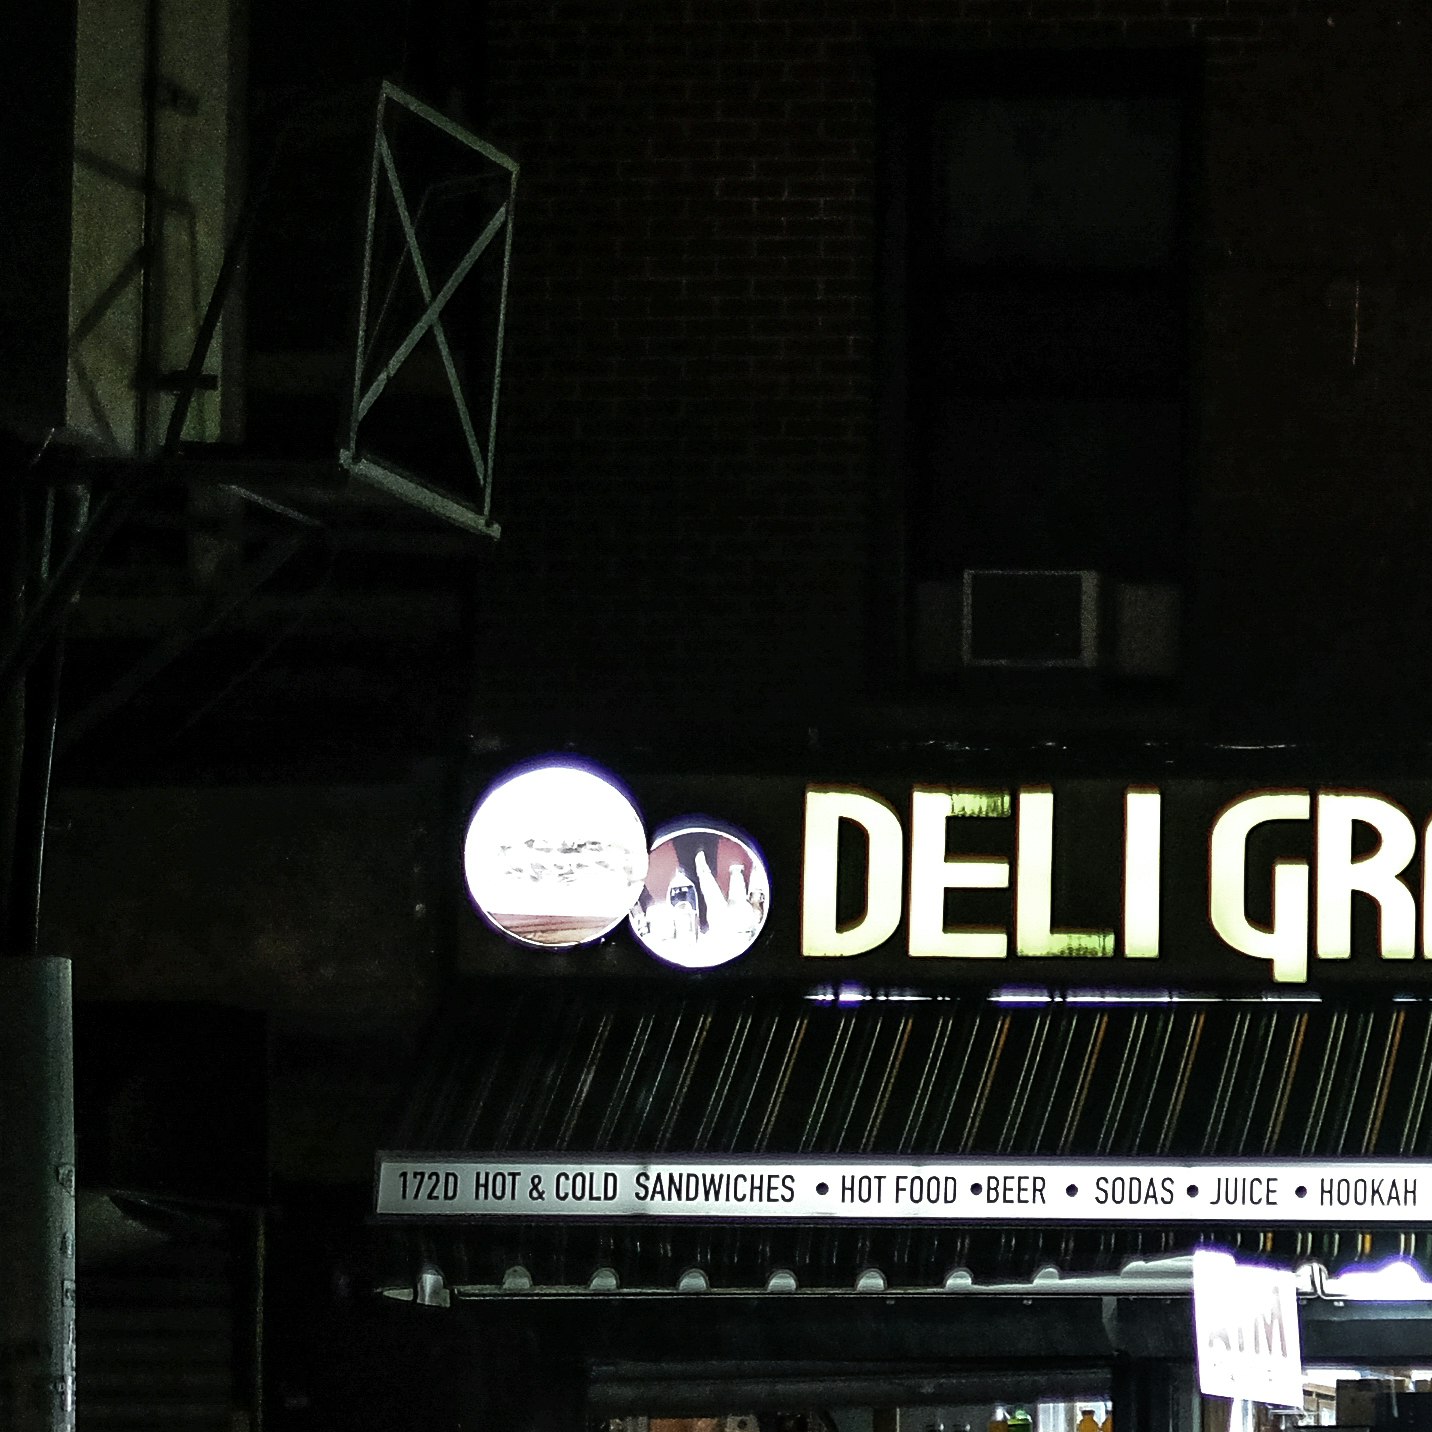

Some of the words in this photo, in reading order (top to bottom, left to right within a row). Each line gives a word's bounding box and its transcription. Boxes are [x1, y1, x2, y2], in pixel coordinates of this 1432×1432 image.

[802, 786, 1161, 958] DELI
[399, 1172, 459, 1201] 172D
[474, 1171, 521, 1201] HOT
[528, 1174, 545, 1202] &
[555, 1172, 618, 1202] COLD
[634, 1172, 796, 1204] SANDWICHES
[841, 1174, 887, 1203] HOT
[895, 1175, 957, 1204] FOOD
[986, 1176, 1046, 1205] BEER
[1094, 1176, 1175, 1205] SODAS
[1209, 1178, 1278, 1206] JUICE
[1319, 1179, 1417, 1207] HOOKAH
